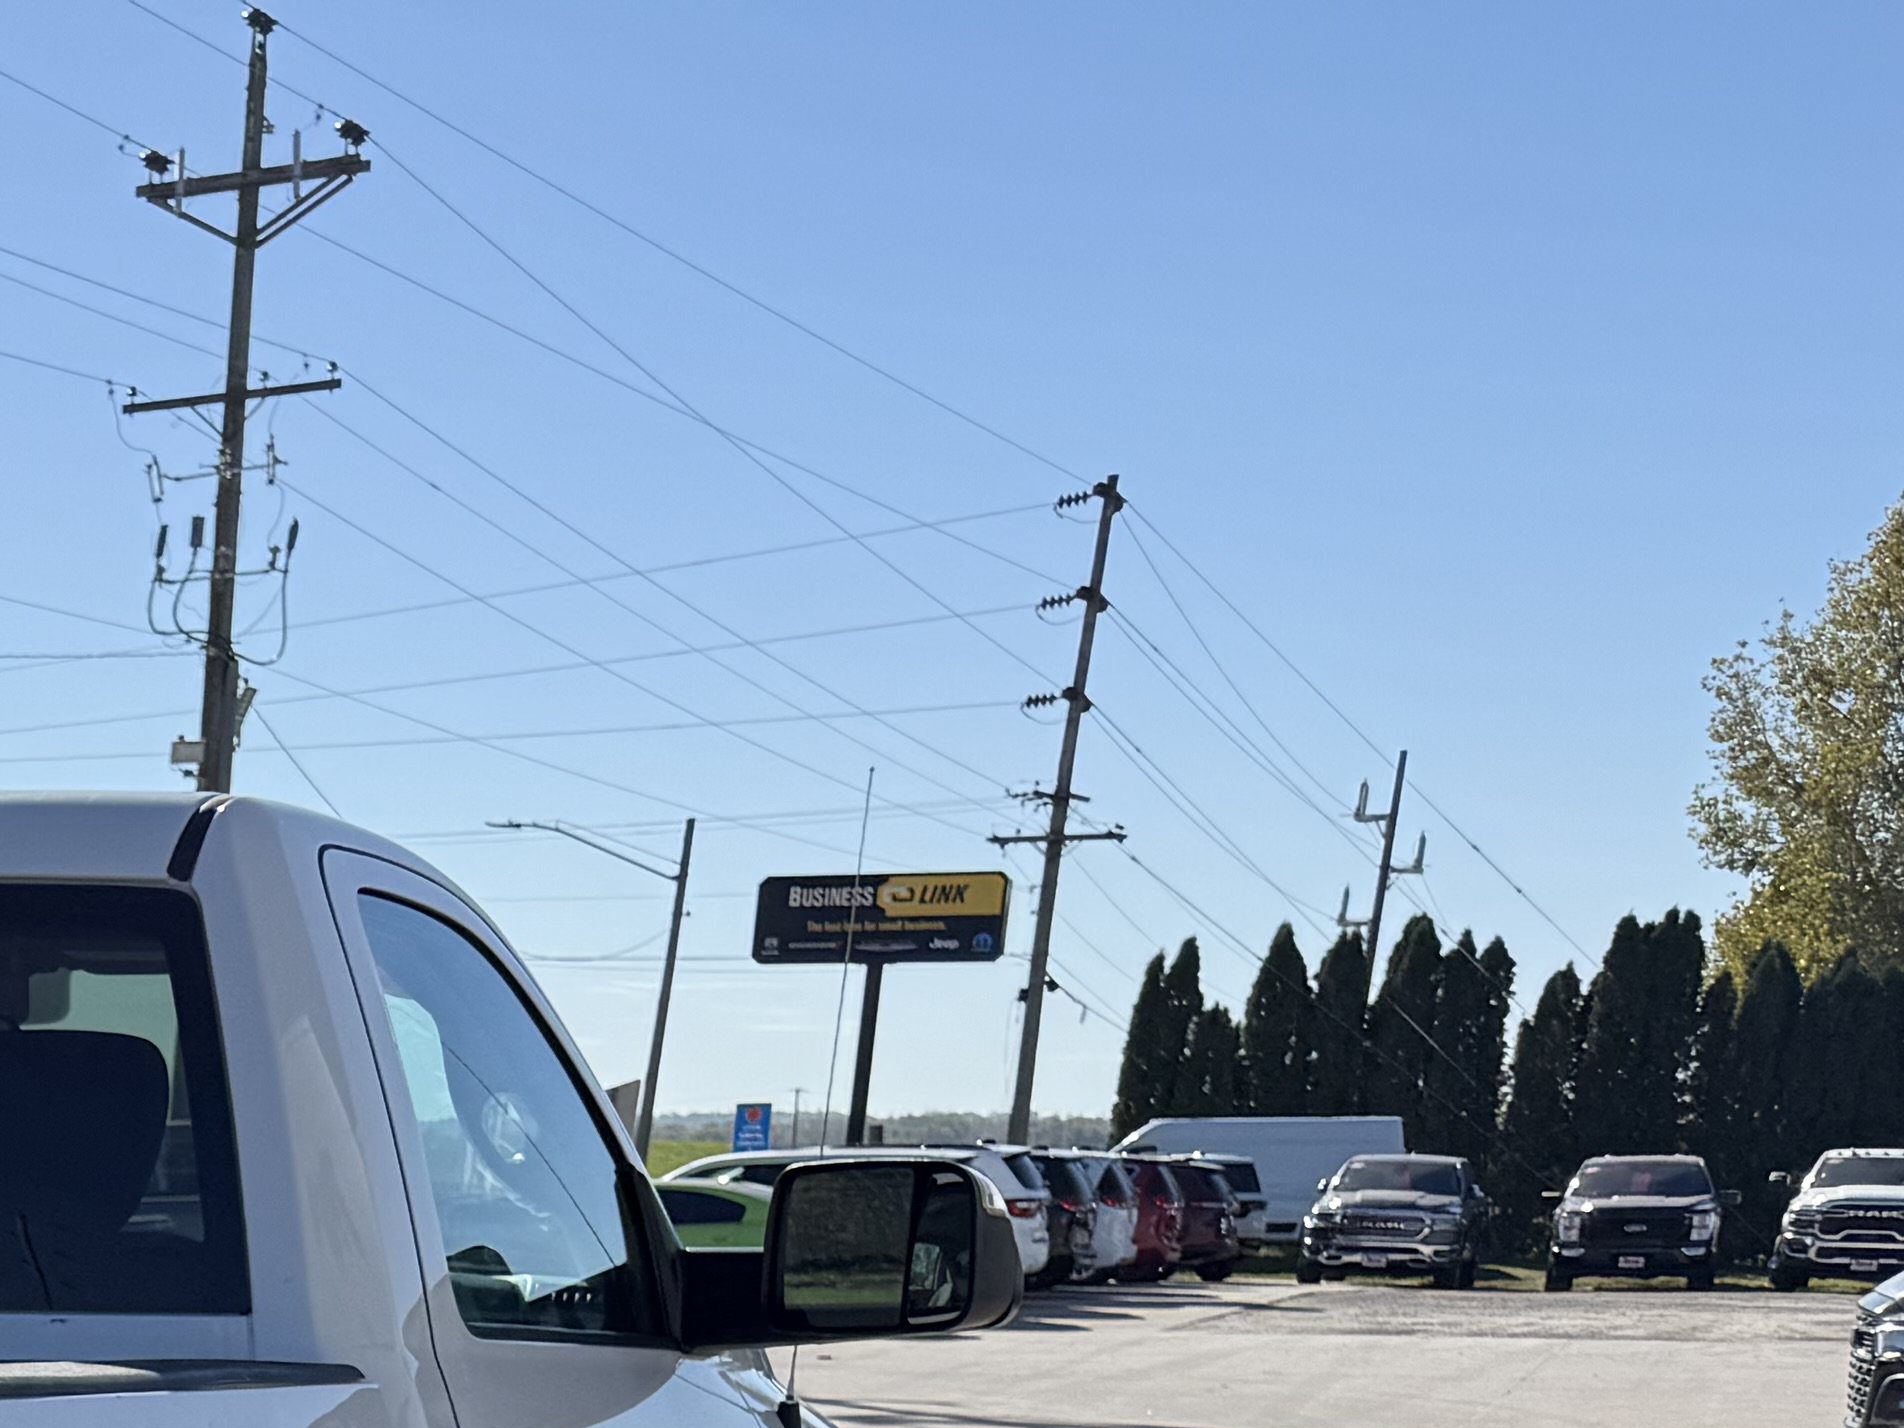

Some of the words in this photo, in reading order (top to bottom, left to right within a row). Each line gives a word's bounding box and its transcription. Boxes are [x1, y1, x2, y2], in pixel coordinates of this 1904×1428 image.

[788, 886, 875, 907] BUSINESS
[919, 884, 971, 905] LINK
[928, 936, 960, 951] Jeep
